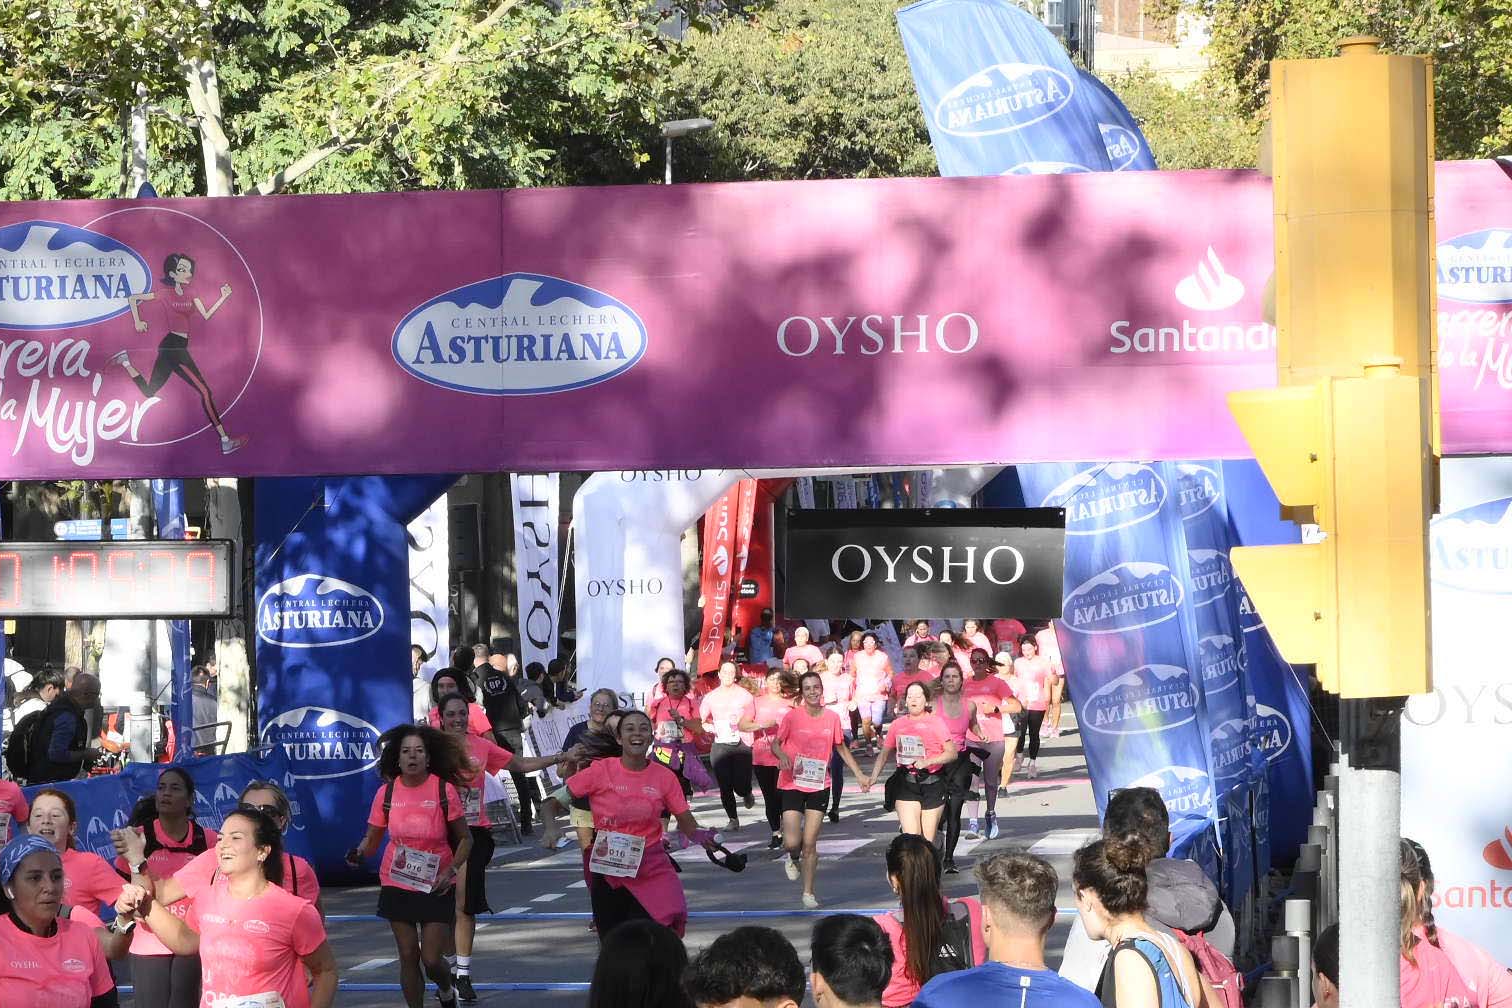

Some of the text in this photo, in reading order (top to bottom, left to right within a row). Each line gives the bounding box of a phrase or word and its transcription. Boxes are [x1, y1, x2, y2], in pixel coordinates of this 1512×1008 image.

[54, 256, 127, 269] LECHERA
[451, 312, 619, 329] CENTRAL LECHERA
[777, 311, 979, 357] OYSHO
[1110, 319, 1277, 354] Santand
[411, 319, 628, 365] ASTURIANA
[12, 372, 162, 467] Mujer
[831, 543, 1026, 585] OYSHO
[587, 578, 663, 597] OYSHO
[261, 604, 375, 631] ASTURIANA
[703, 580, 728, 654] Sports
[278, 741, 376, 761] TURIANA
